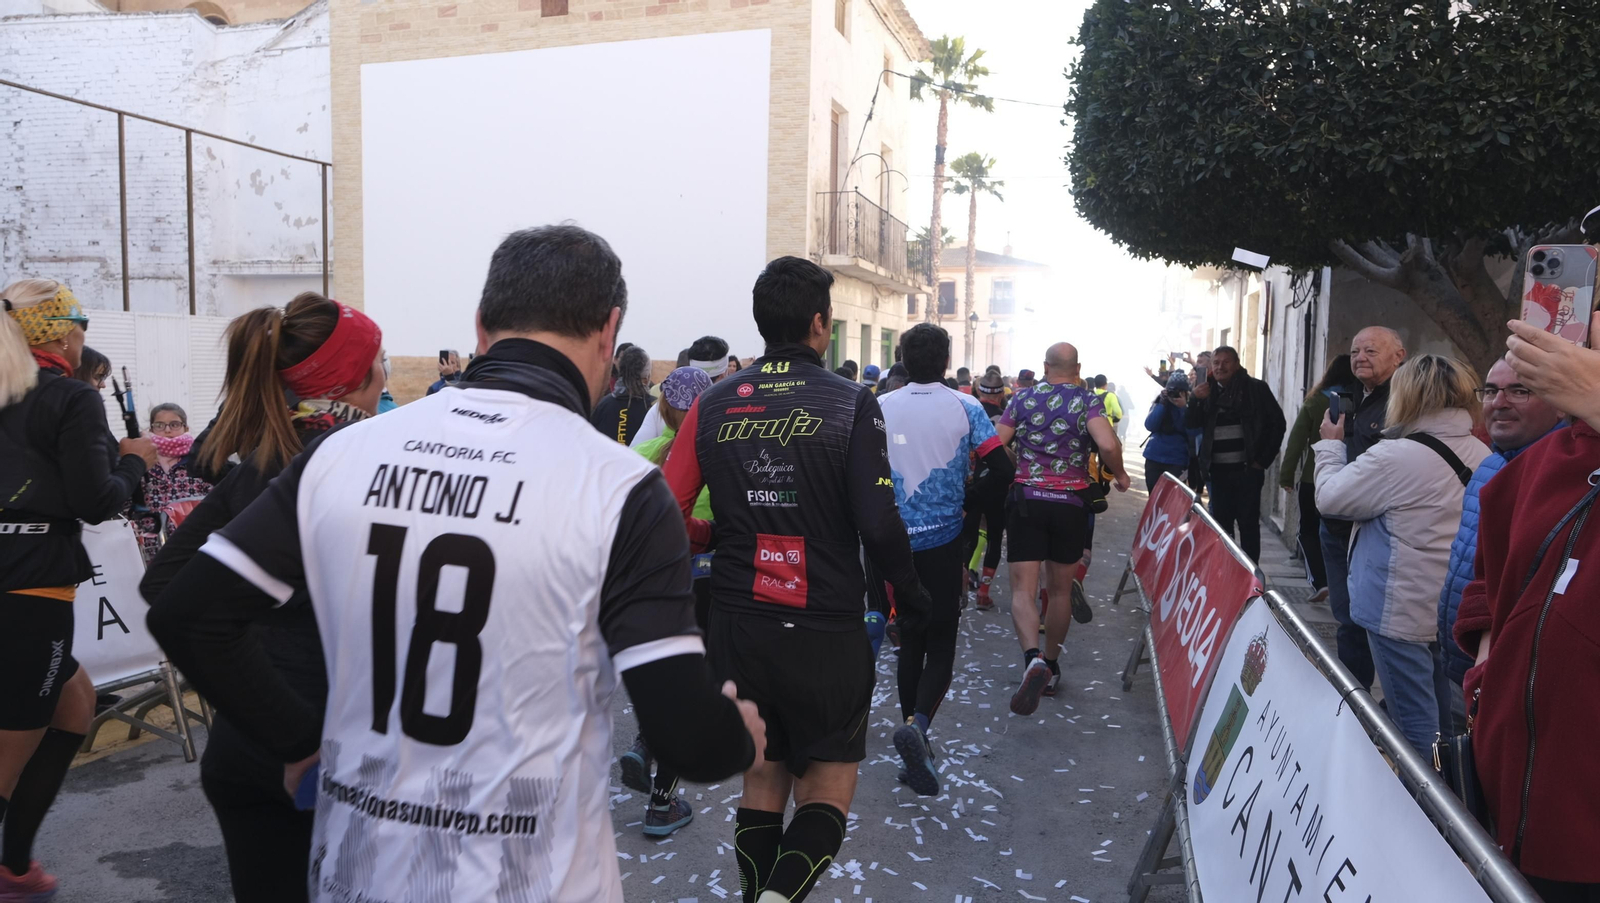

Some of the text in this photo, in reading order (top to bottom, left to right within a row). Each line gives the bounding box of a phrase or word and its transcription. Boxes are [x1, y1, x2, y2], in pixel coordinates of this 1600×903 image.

[404, 440, 517, 465] CANTORIA F.C.
[363, 463, 525, 526] ANTONIO J.
[746, 490, 797, 502] FISIOFIT
[0, 522, 50, 534] ONE3
[366, 522, 496, 746] 18
[1256, 699, 1372, 903] AYUNTAMIE
